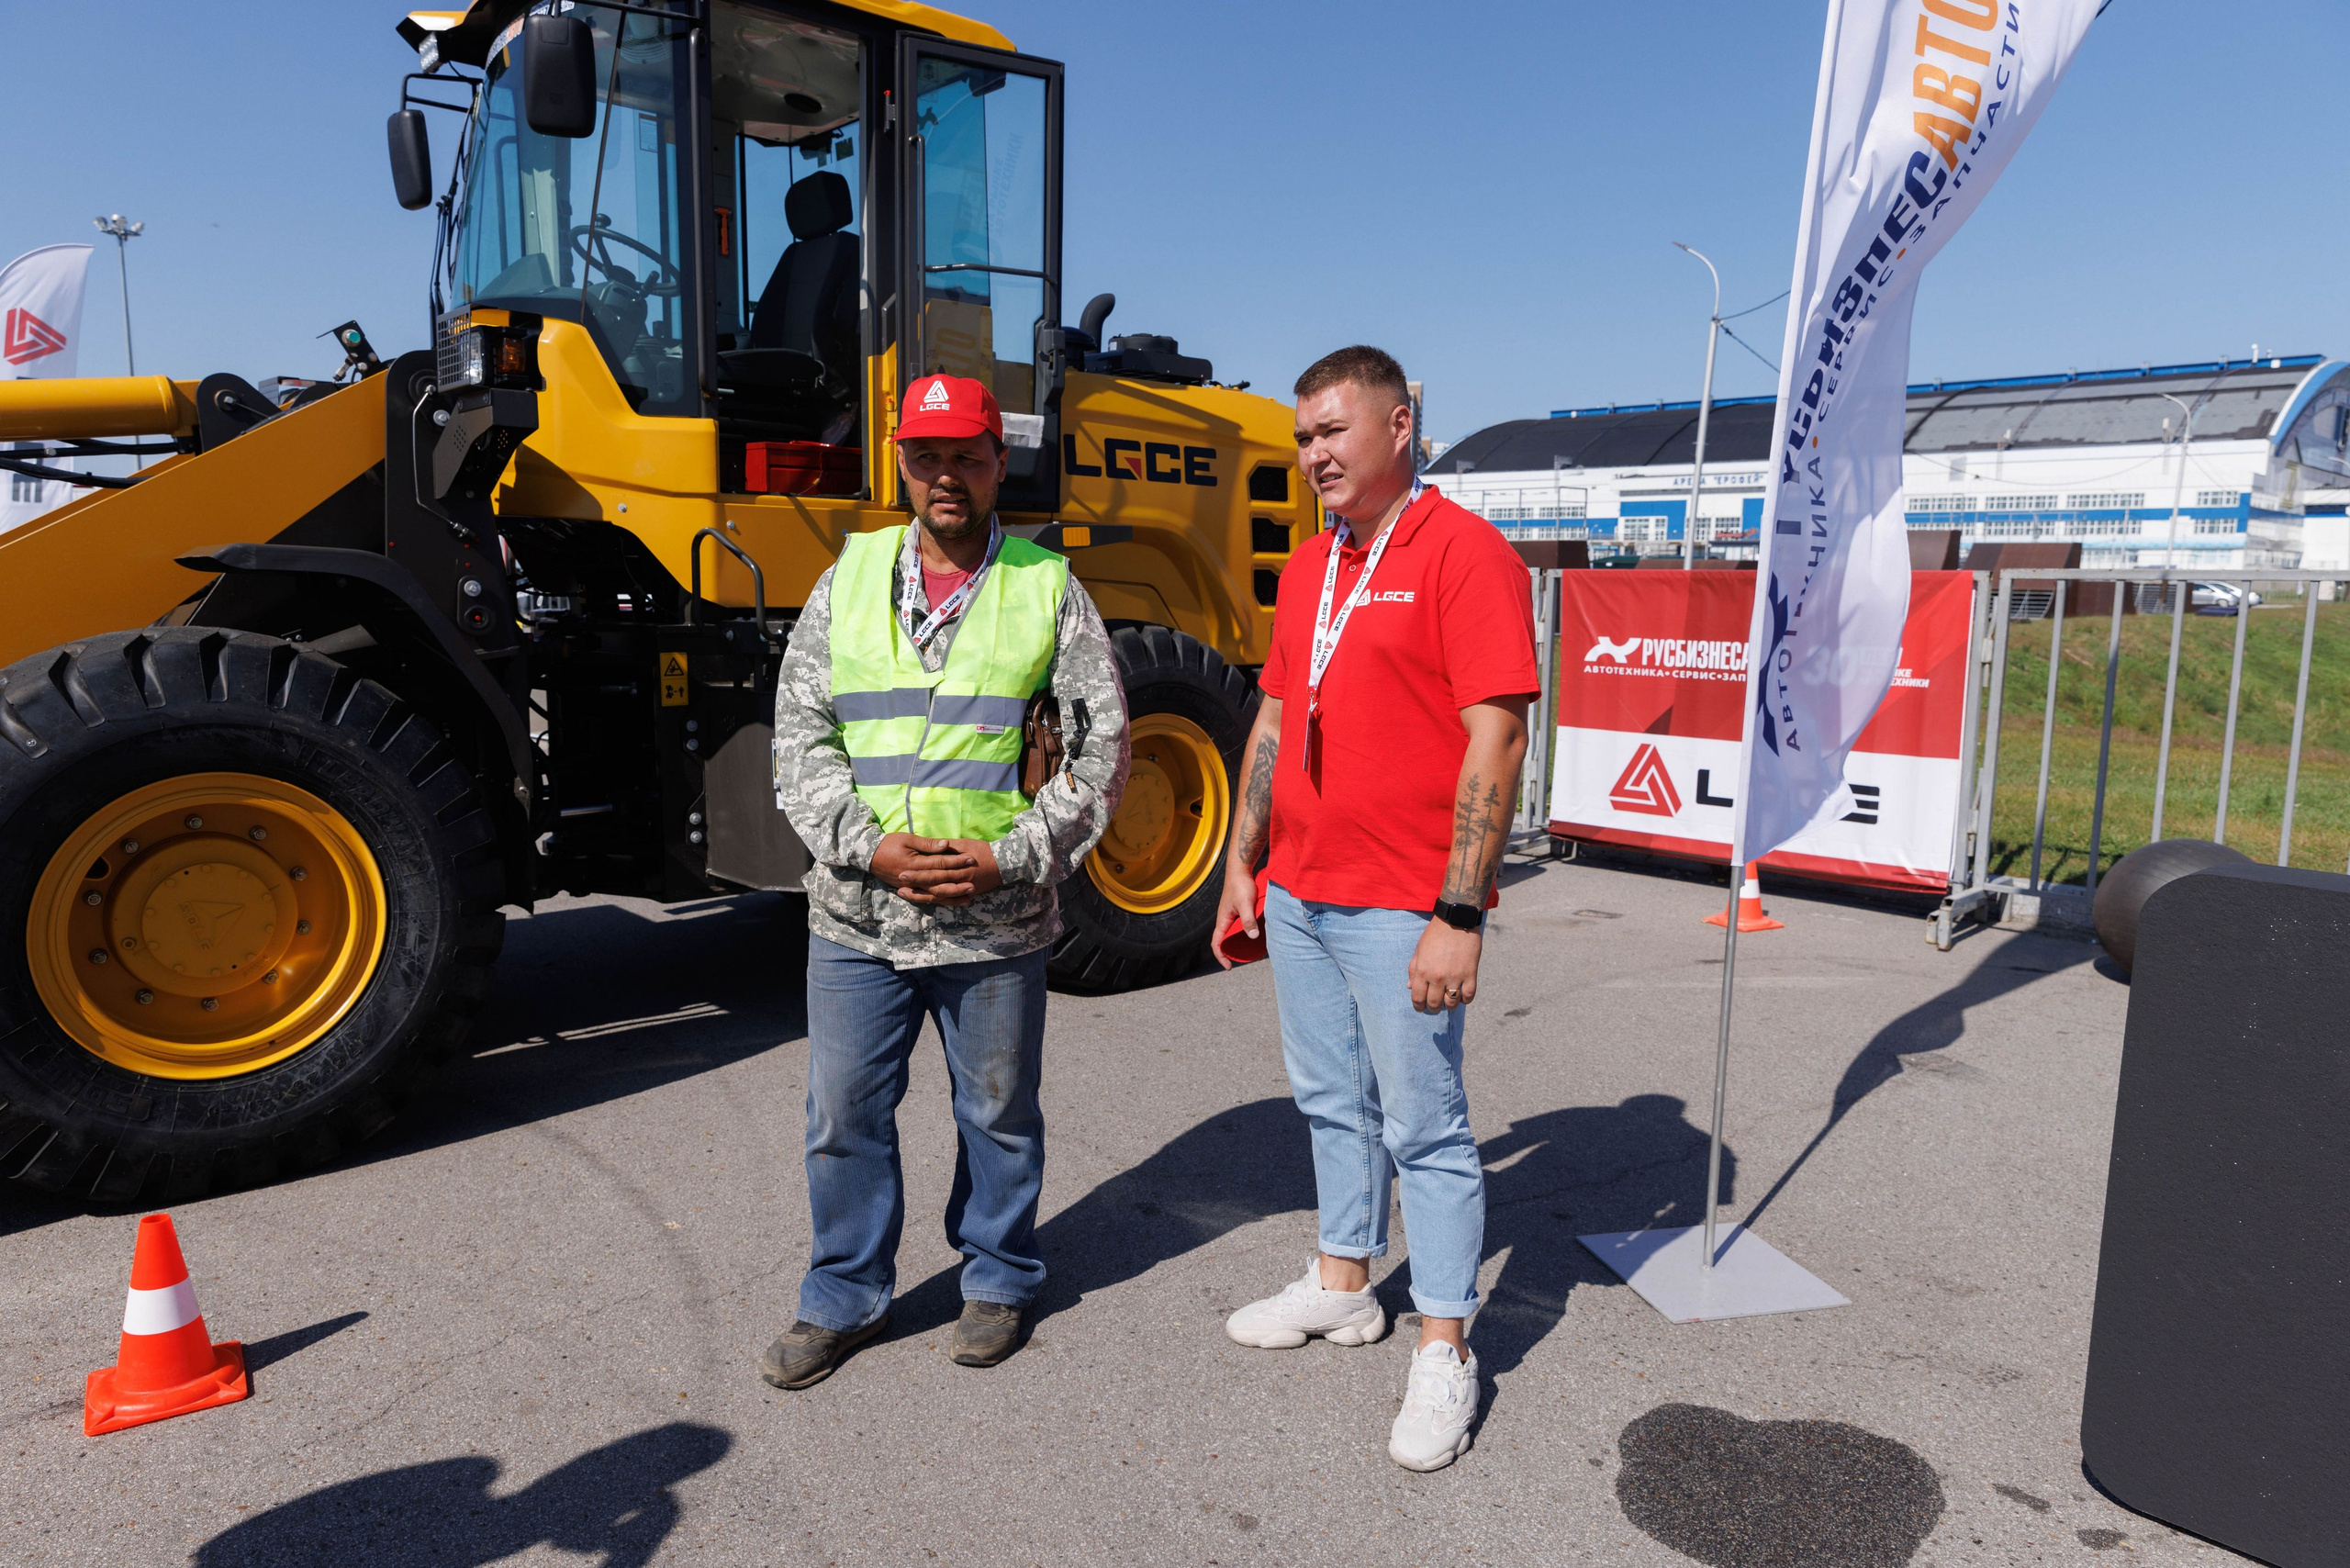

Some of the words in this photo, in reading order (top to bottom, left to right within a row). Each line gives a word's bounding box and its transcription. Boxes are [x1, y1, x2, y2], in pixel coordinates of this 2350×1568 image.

[1818, 264, 1894, 423] СЕРВИС
[1908, 1, 2020, 244] ЗАПЧАСТИ
[919, 402, 951, 412] LGCE
[1063, 433, 1218, 487] LGCE
[1673, 476, 1706, 487] АРЕА
[1372, 590, 1415, 602] LGCE
[1641, 637, 1750, 671] РУСБИЗНЕСА
[1672, 670, 1717, 680] СЕРВИС
[1722, 673, 1747, 682] ЗАП
